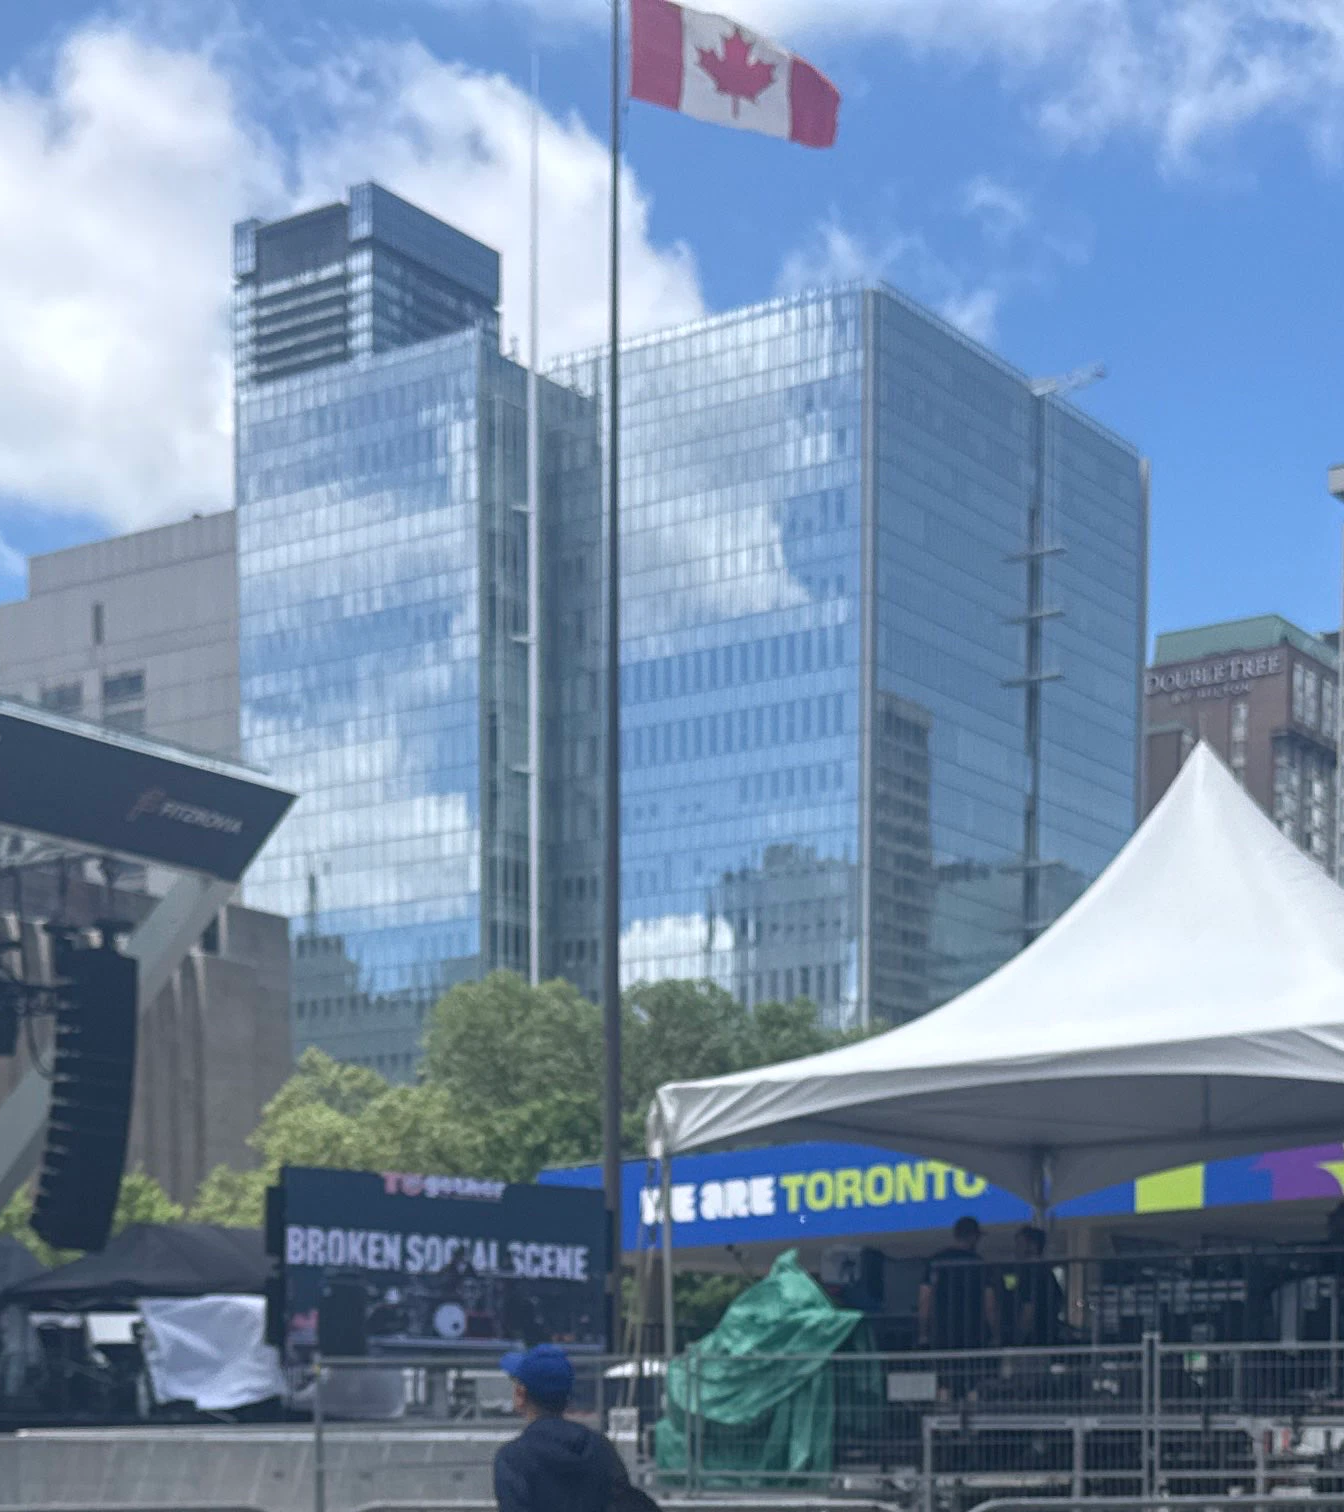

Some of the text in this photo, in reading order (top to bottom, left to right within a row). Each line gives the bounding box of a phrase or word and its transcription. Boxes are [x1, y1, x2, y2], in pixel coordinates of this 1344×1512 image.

[700, 1177, 777, 1221] ARE
[779, 1158, 988, 1213] TORONTO
[285, 1224, 402, 1271] BROKEN
[508, 1241, 590, 1283] SCENE
